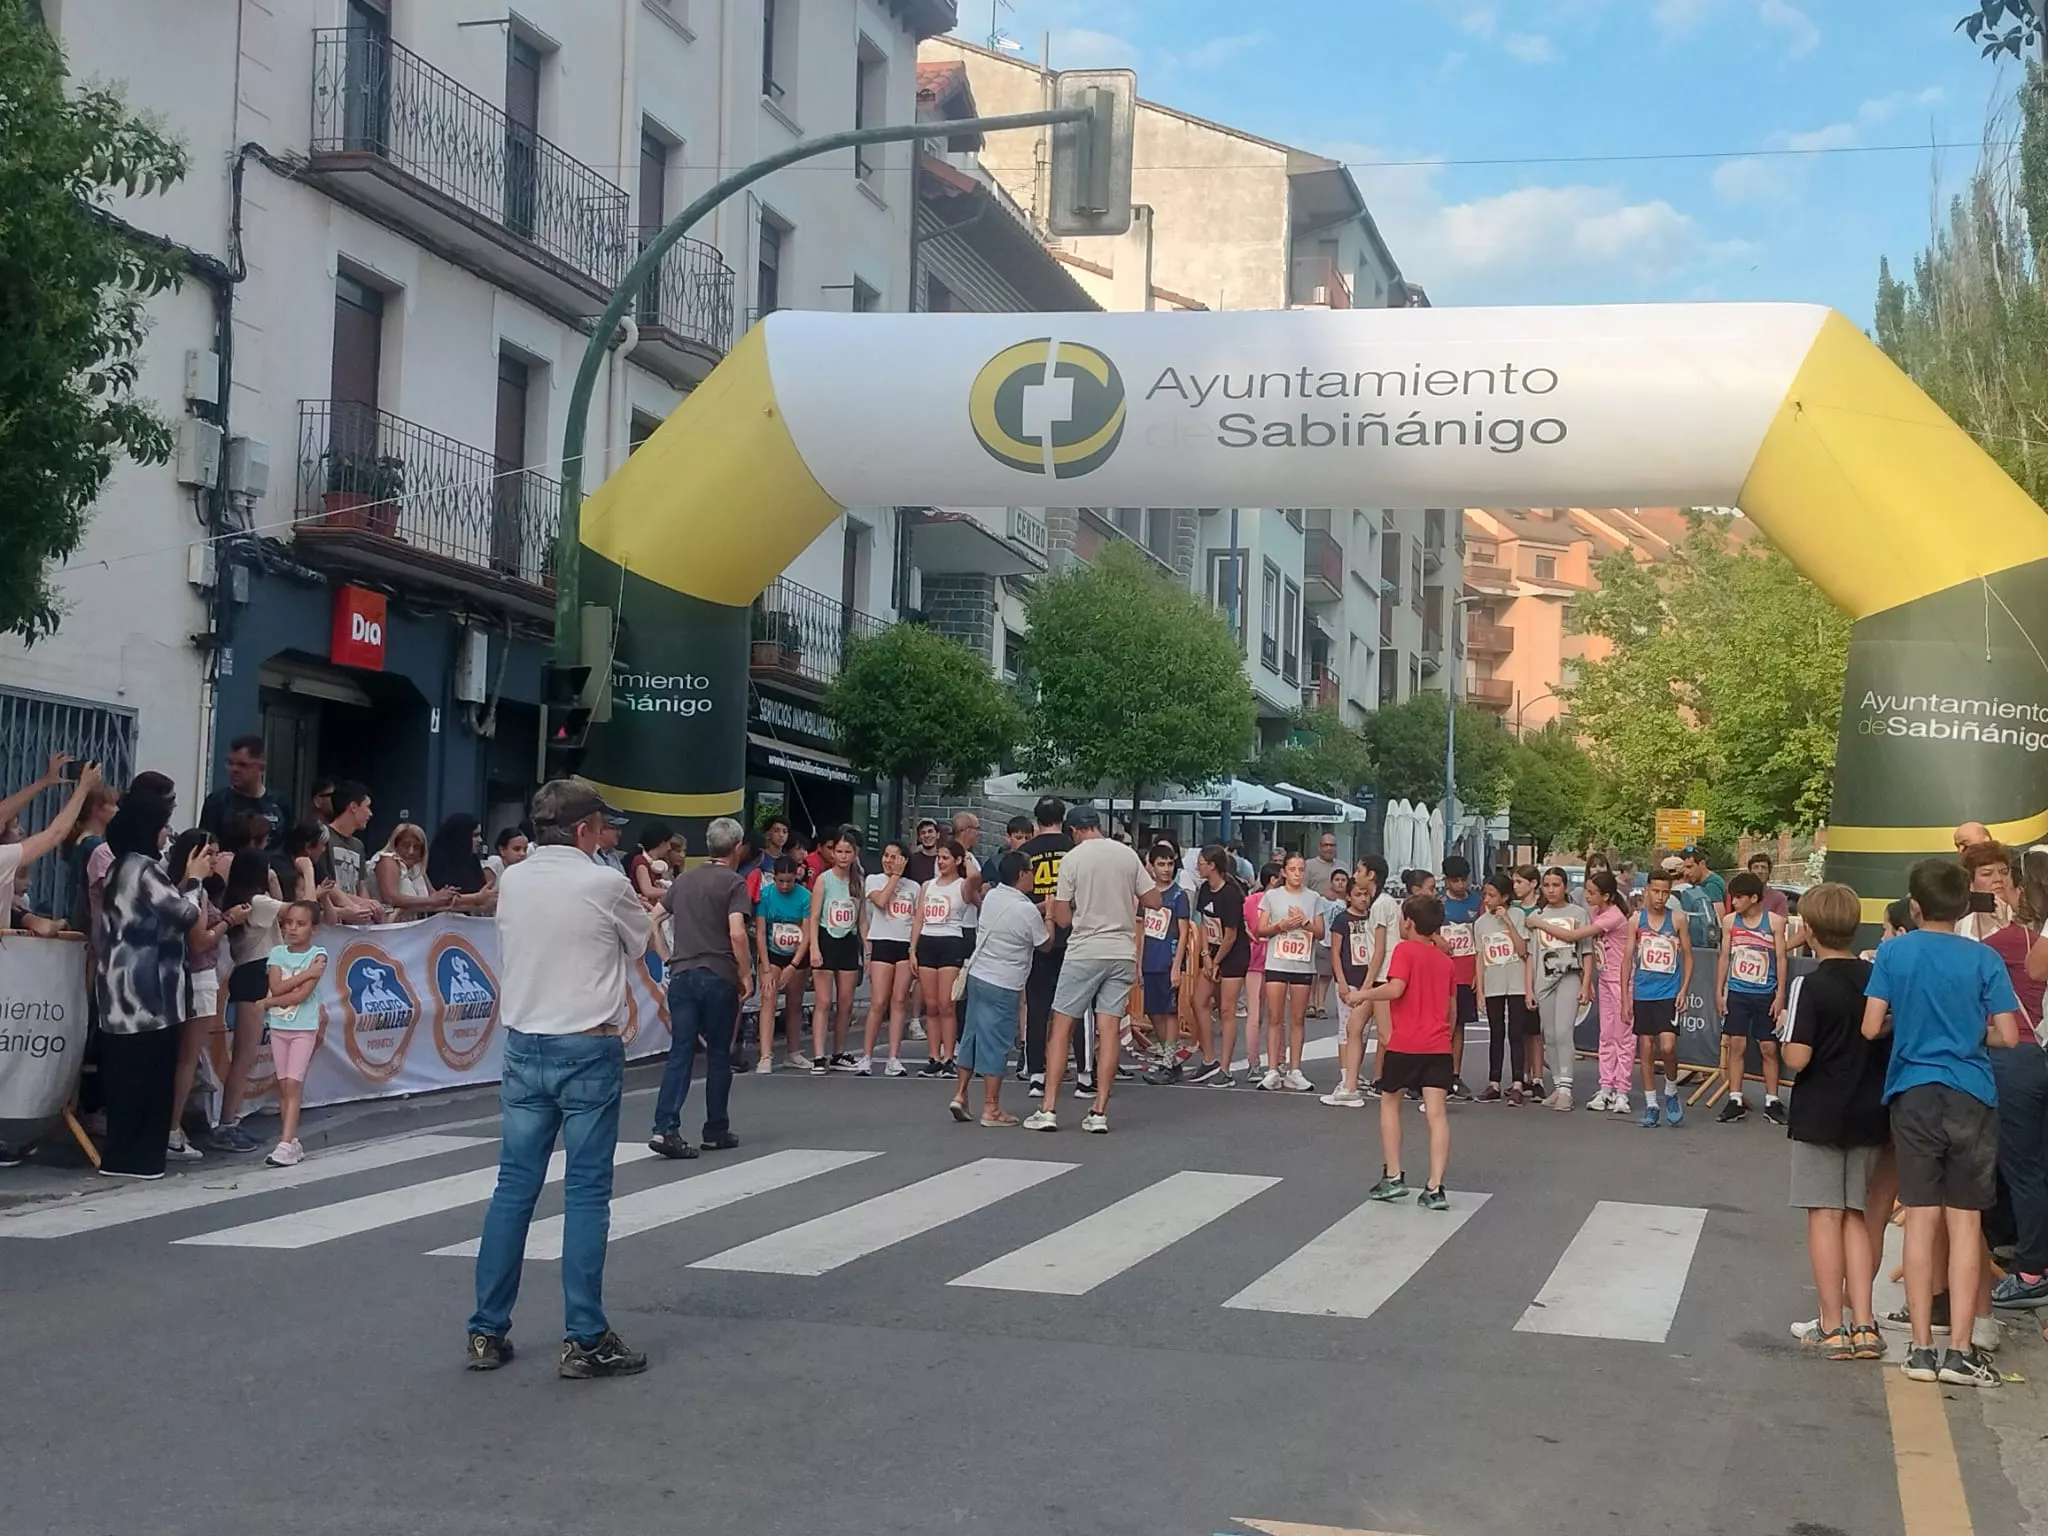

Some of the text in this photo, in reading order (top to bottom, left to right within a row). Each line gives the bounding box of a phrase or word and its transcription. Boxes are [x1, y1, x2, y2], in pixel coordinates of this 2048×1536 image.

[1145, 363, 1560, 408] Ayuntamiento
[1216, 410, 1568, 454] Sabiñánigo
[1016, 512, 1046, 549] CENTRO
[760, 697, 792, 729] SERVICIOS
[835, 910, 854, 922] 601
[925, 905, 945, 918] 606
[1282, 940, 1304, 955] 602
[1489, 943, 1511, 958] 616
[1646, 949, 1671, 965] 625
[1739, 960, 1761, 977] 621
[452, 991, 488, 1004] CIRCUITO
[364, 999, 402, 1014] CIRCUITO
